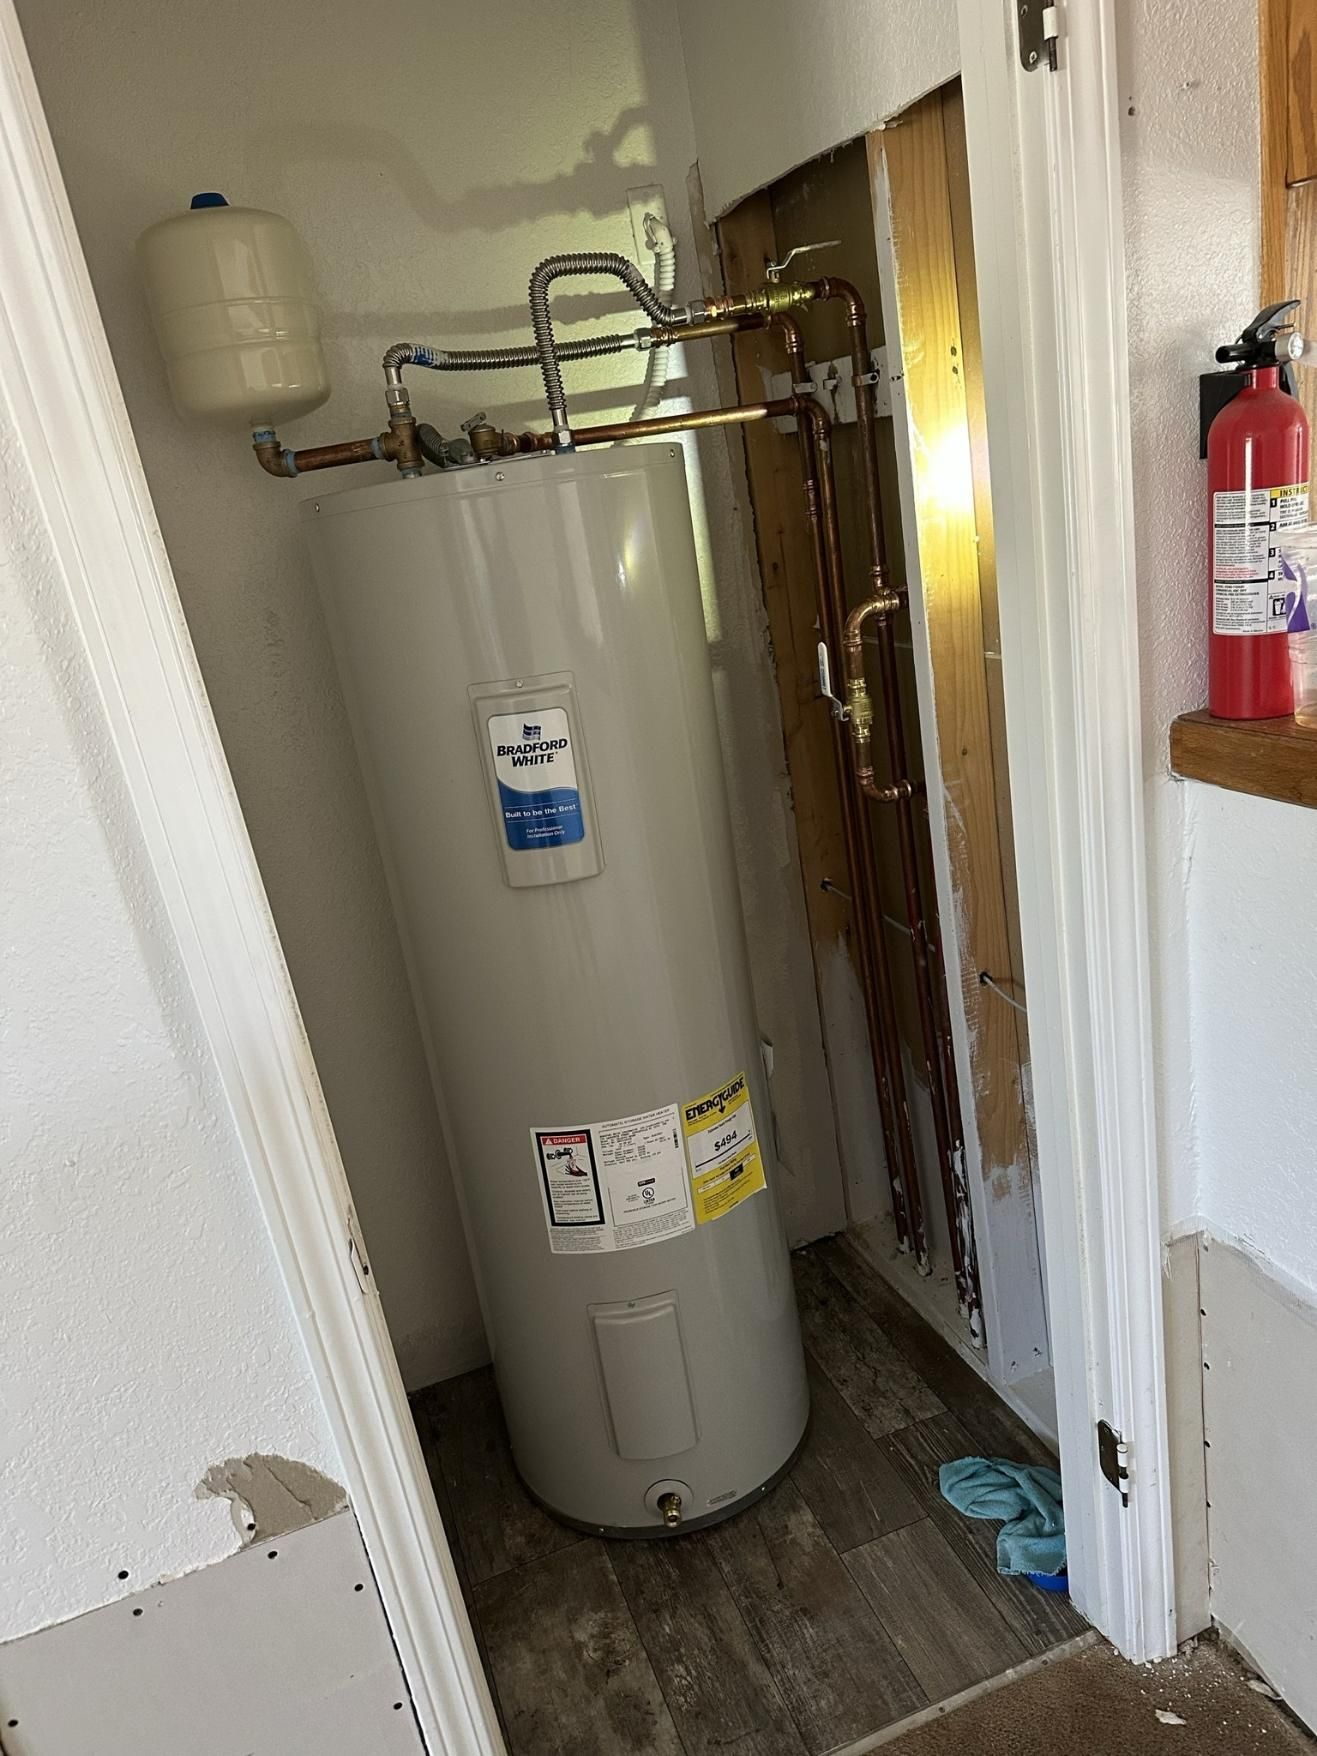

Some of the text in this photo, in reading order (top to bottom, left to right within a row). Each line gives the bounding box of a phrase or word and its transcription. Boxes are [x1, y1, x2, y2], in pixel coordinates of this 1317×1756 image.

[497, 738, 568, 757] BRADFORD
[511, 753, 555, 767] WHITE
[505, 811, 522, 819] Built
[558, 804, 577, 812] Best
[685, 1076, 745, 1121] ENERGYGUIDE
[714, 1129, 738, 1152] $494
